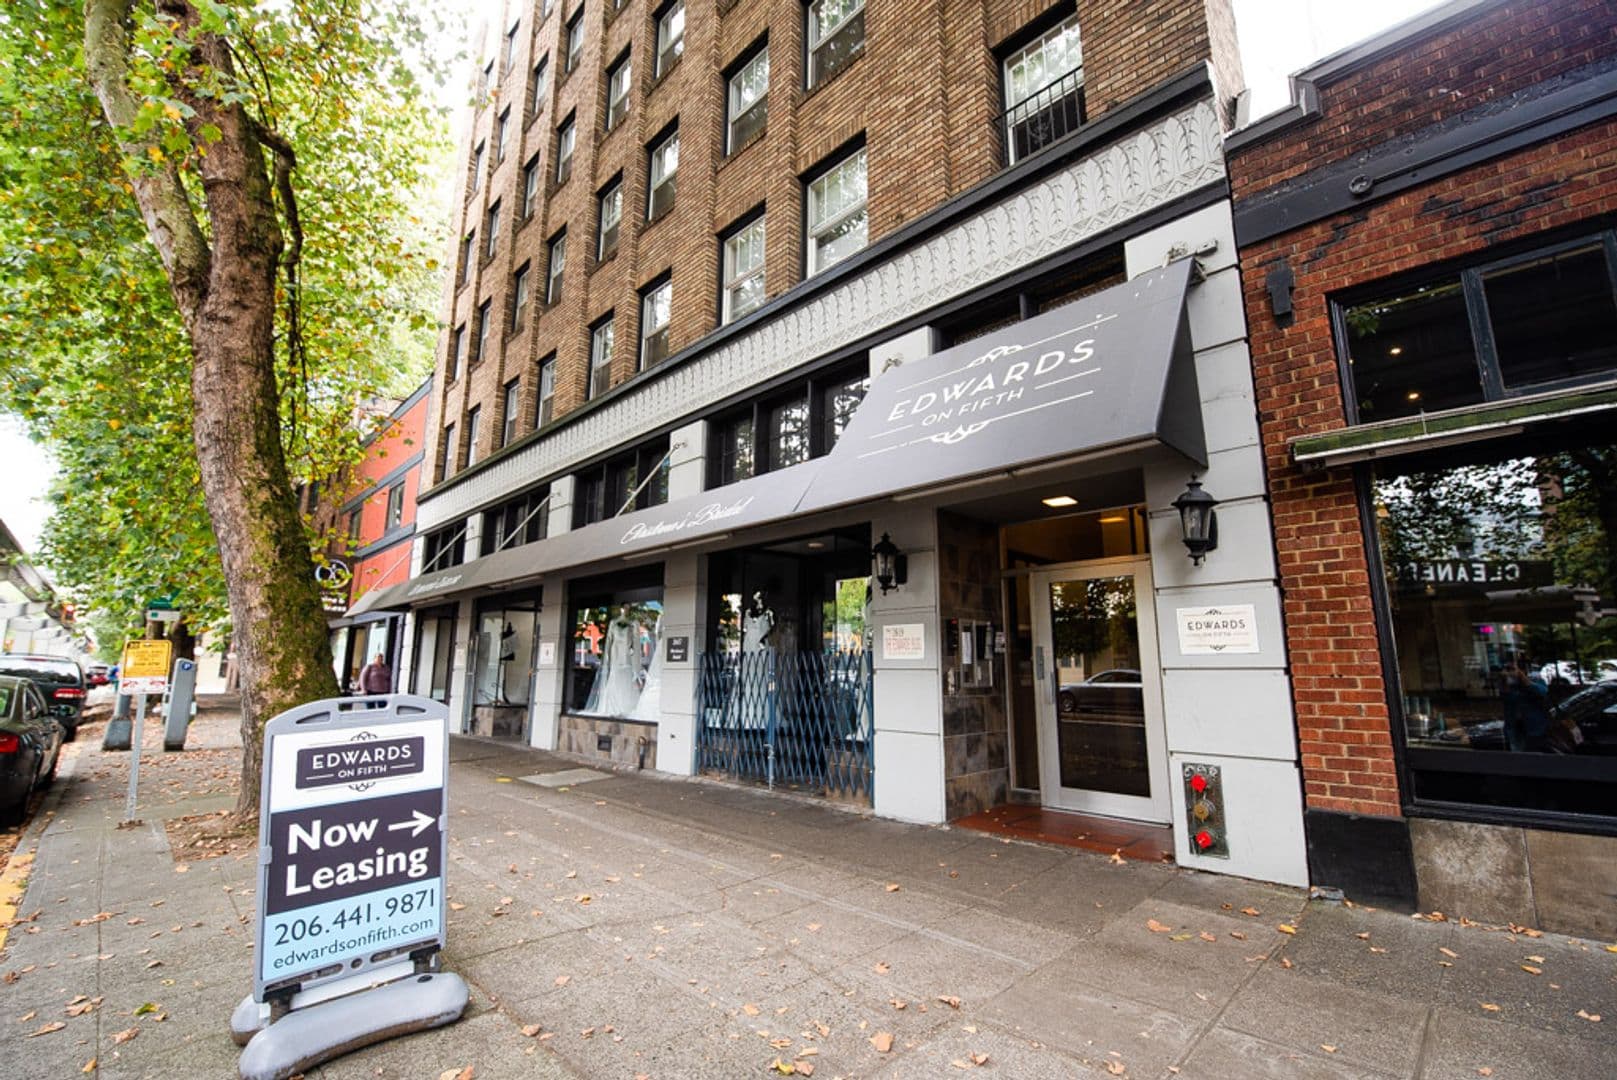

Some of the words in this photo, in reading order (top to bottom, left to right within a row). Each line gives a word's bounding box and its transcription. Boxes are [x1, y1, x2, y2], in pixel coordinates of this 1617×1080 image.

[887, 339, 1095, 422] EDWARDS
[922, 409, 953, 427] ON
[958, 387, 1025, 417] FIFTH
[1187, 619, 1246, 631] EDWARDS
[312, 744, 412, 770] EDWARDS
[338, 769, 355, 778] ON
[356, 765, 387, 777] FIFTH
[287, 818, 379, 855] Now
[286, 847, 429, 897] Leasing
[274, 888, 435, 947] 206.441.9871
[273, 918, 434, 970] edwardsonfifth.com
